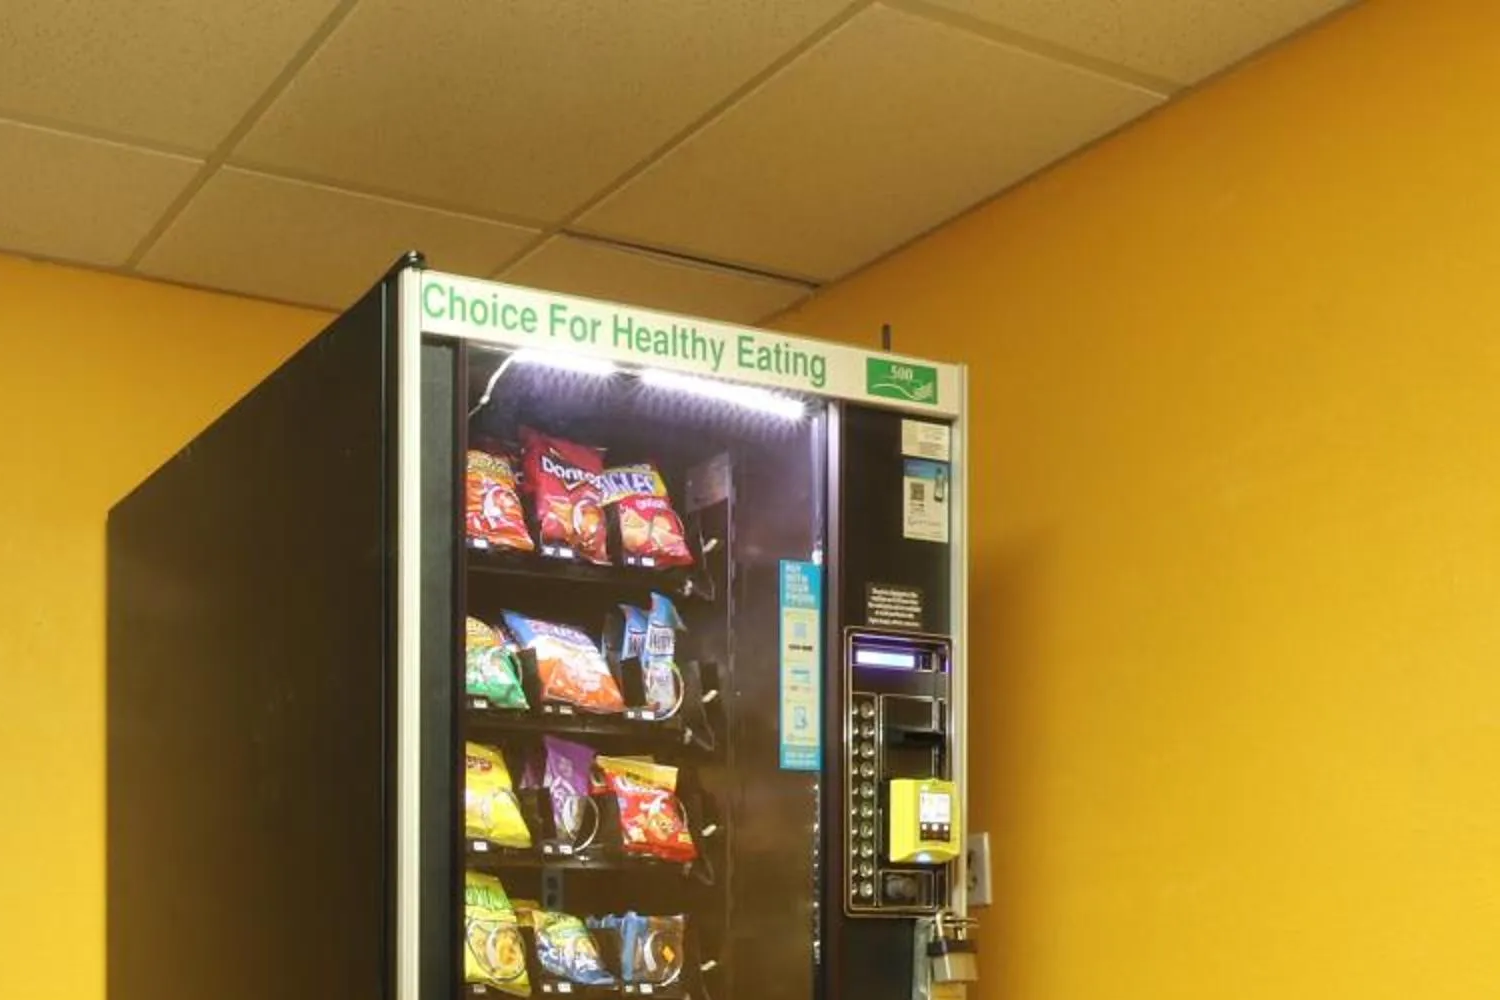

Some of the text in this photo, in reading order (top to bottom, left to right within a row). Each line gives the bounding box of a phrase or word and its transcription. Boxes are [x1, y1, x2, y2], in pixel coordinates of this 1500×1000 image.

[422, 282, 826, 388] Choice For Healthy Eating
